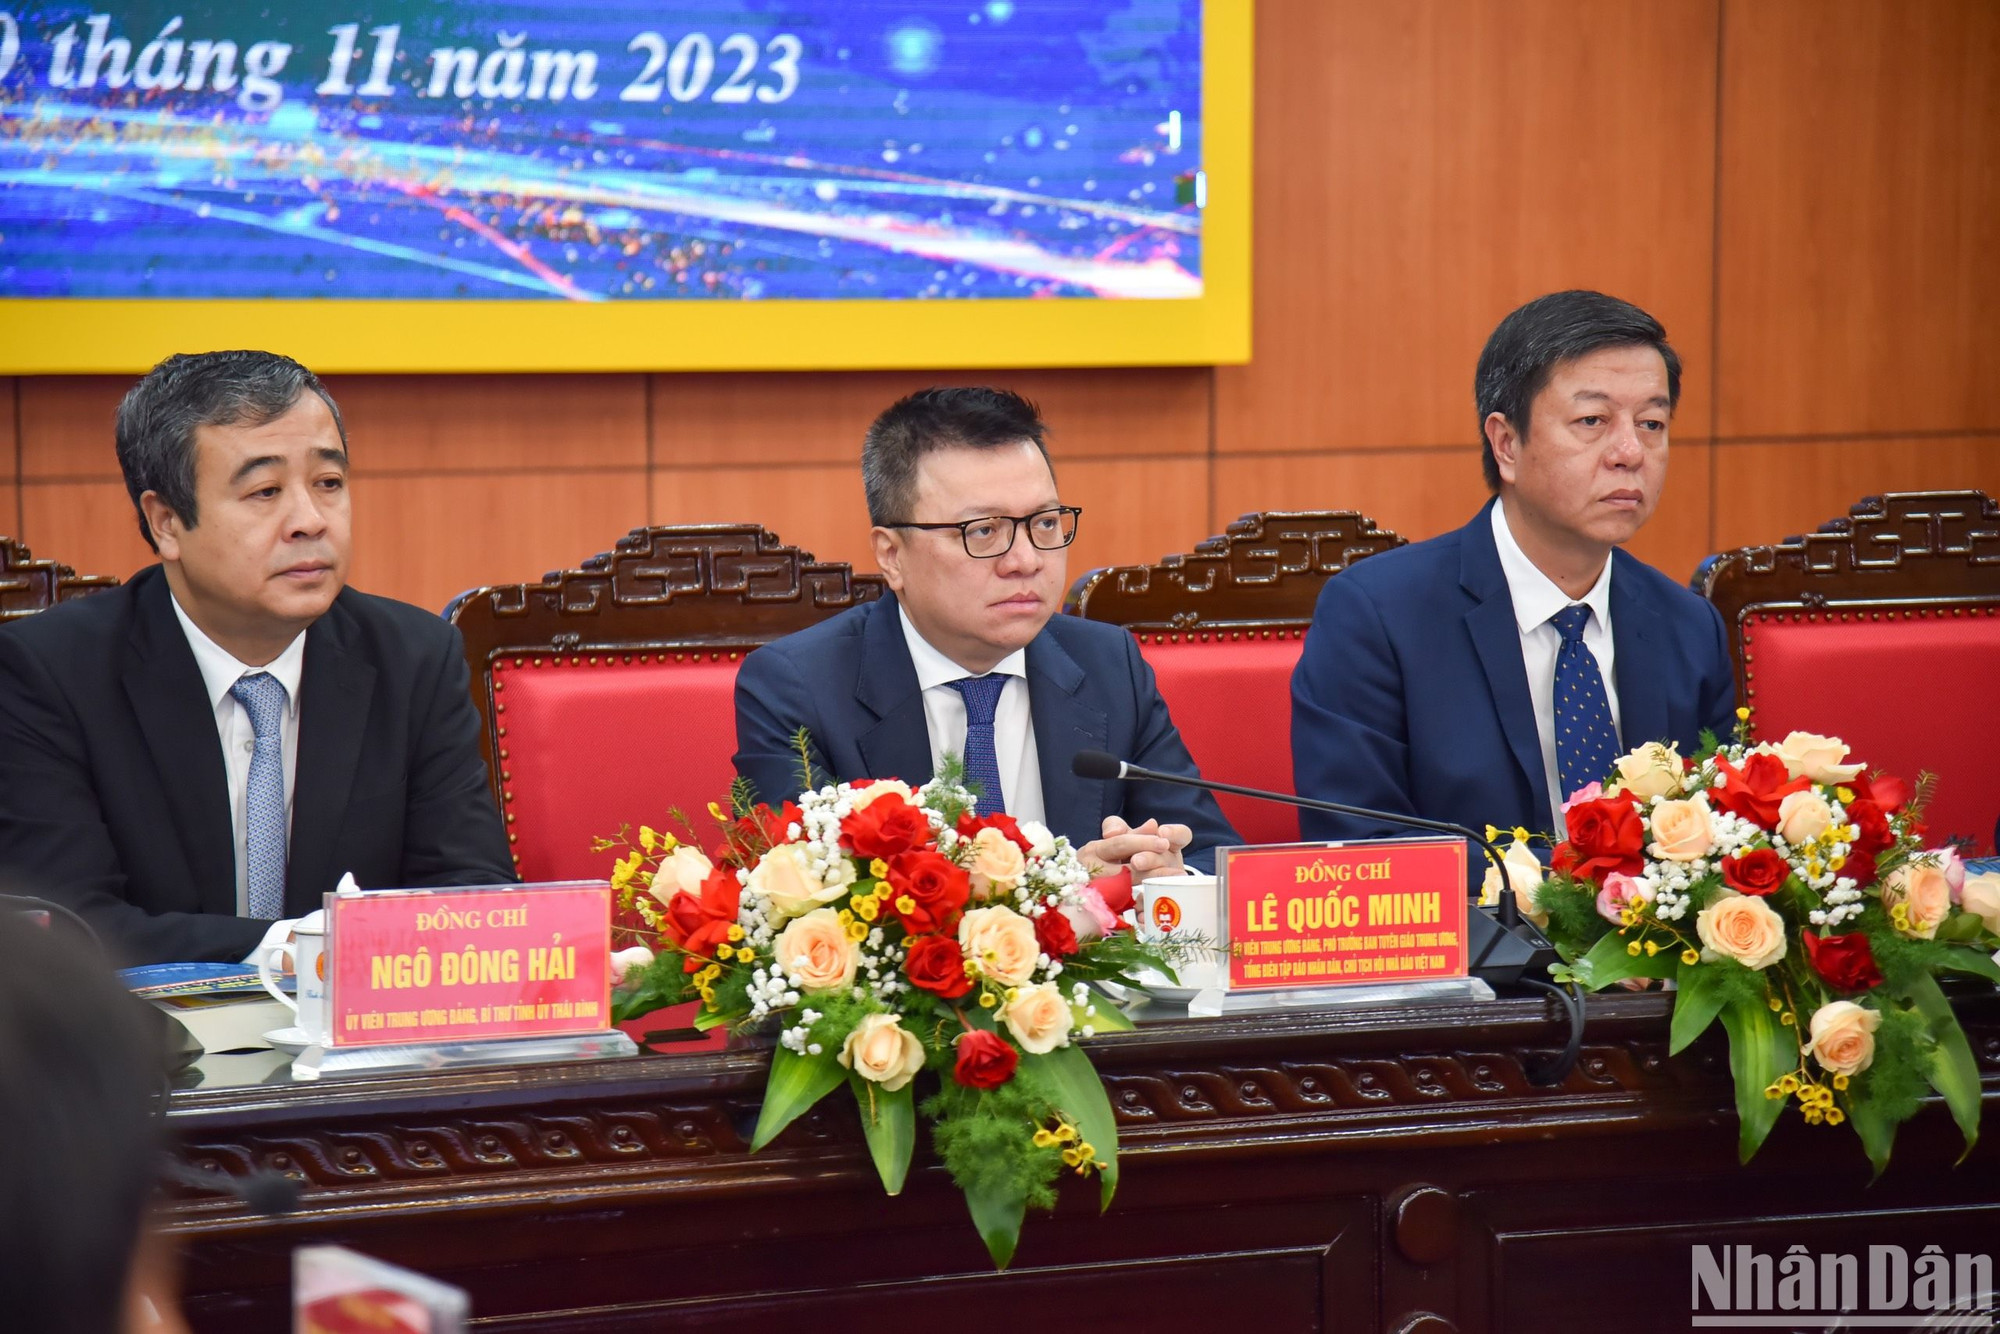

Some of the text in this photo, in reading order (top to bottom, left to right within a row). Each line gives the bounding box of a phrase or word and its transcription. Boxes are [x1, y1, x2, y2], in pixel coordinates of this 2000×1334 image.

[49, 14, 291, 110] tháng
[316, 24, 398, 96] 11
[427, 30, 598, 100] năm
[620, 32, 801, 103] 2023
[1295, 858, 1391, 883] ĐỒNG CHÍ
[416, 904, 528, 931] ĐỒNG CHÍ
[1247, 885, 1440, 933] LÊ QUỐC MINH
[371, 933, 575, 989] NGÔ ĐÔNG HẢI
[361, 1009, 385, 1030] VIÊN
[386, 1011, 419, 1028] TRUNG
[536, 997, 549, 1020] ỦY
[551, 999, 573, 1019] THÁI
